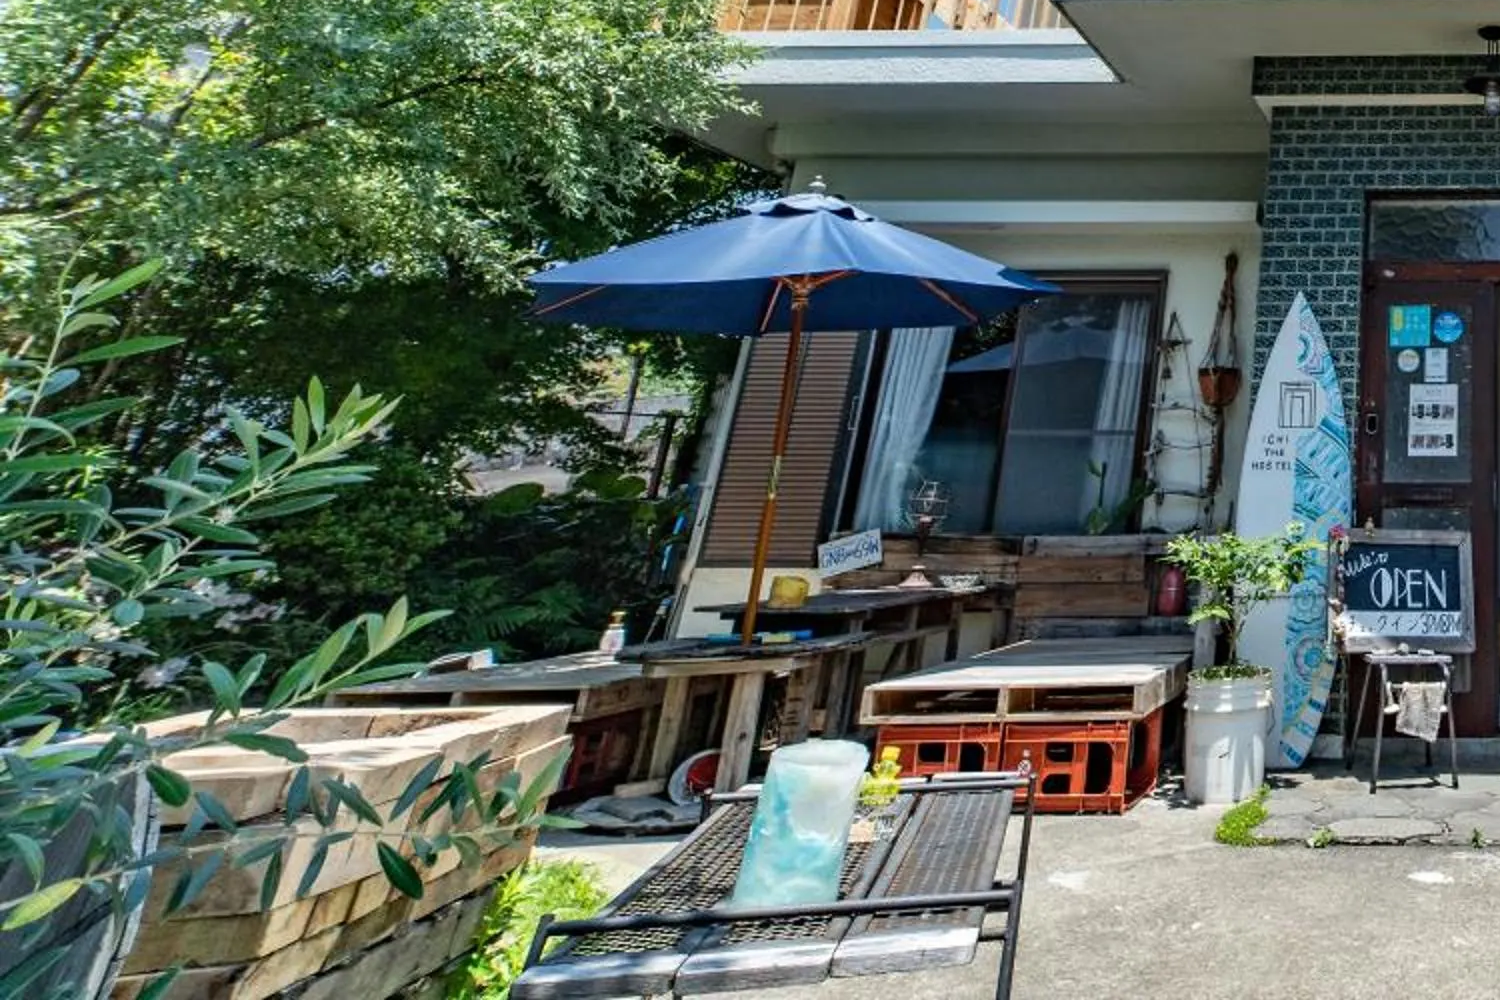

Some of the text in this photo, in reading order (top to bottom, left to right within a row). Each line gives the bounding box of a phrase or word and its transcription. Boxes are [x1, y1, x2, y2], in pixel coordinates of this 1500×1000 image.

[1262, 433, 1289, 445] ICHI
[1264, 447, 1284, 457] THE
[1251, 461, 1291, 471] HOSTEL
[1369, 567, 1447, 609] OPEN
